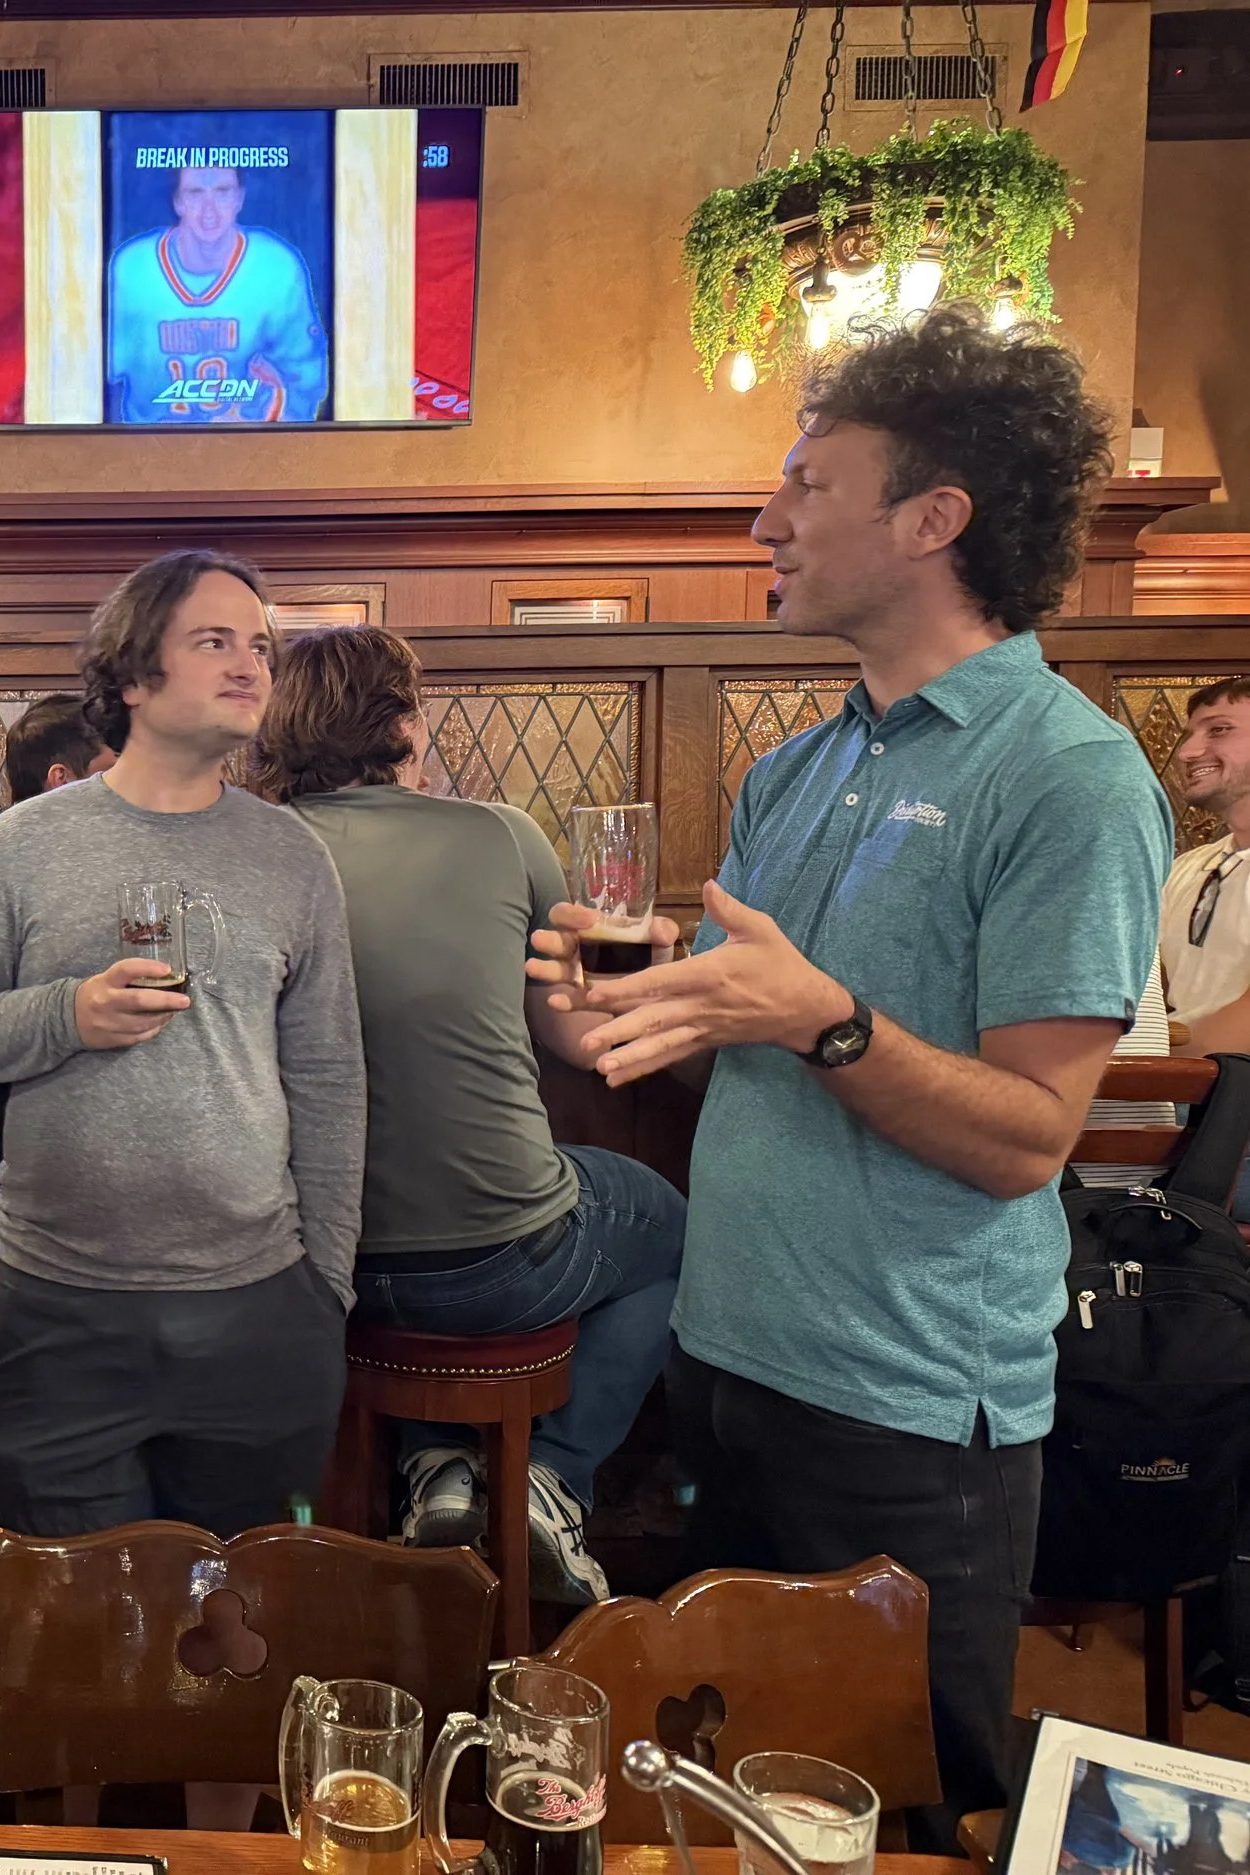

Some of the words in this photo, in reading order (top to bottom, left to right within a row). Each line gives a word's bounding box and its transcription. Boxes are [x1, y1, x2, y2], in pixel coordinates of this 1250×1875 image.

[136, 147, 188, 168] BREAK
[190, 147, 206, 168] IN
[208, 147, 289, 168] PROGRESS
[1120, 1462, 1190, 1476] PINNACLE
[535, 1778, 561, 1795] The
